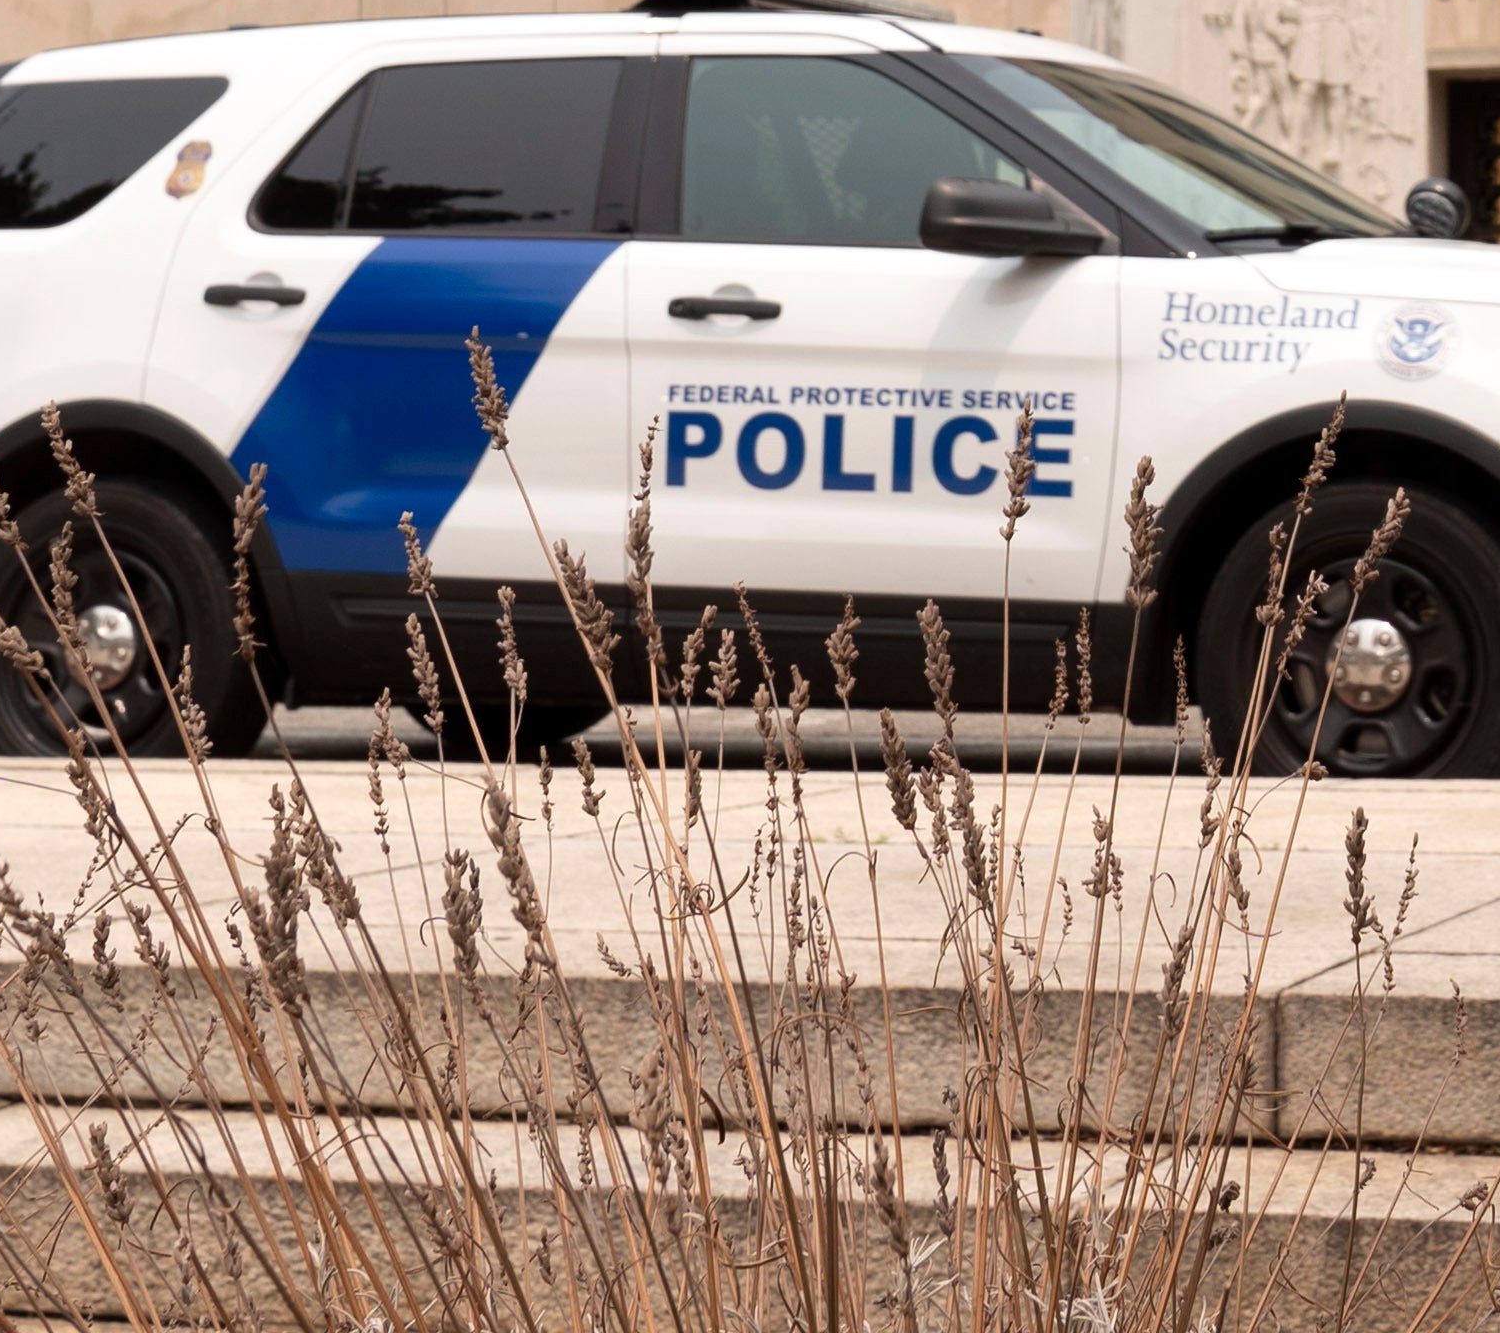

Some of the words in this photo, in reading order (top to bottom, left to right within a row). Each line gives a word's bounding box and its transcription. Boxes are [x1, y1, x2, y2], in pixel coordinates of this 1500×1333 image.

[1162, 291, 1361, 330] Homeland
[1157, 329, 1311, 374] Security
[668, 384, 780, 404] FEDERAL
[790, 386, 953, 409] PROTECTIVE
[962, 389, 1077, 411] SERVICE
[665, 411, 1077, 499] POLICE
